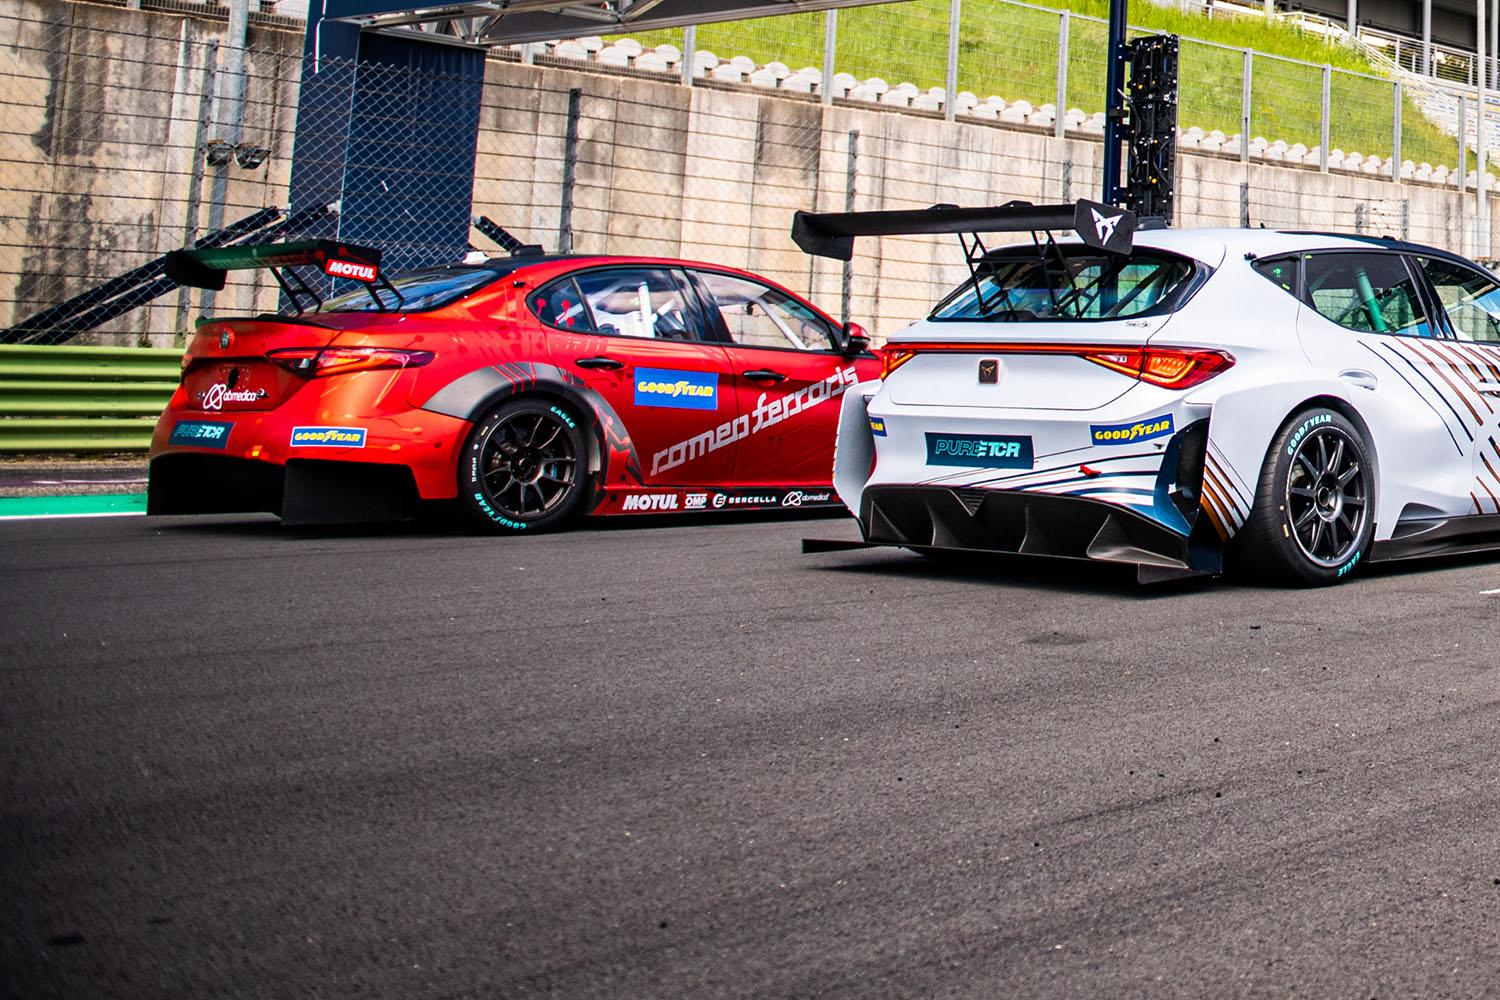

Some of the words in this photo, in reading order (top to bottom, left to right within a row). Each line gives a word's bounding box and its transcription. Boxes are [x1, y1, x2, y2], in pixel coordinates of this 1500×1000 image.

[329, 261, 374, 279] MOTUL
[637, 380, 714, 398] GOODYEAR
[550, 406, 576, 429] EAGLE
[650, 414, 749, 477] romeo
[752, 366, 859, 434] ferraris
[294, 431, 361, 443] GOODYEAR
[1094, 420, 1170, 440] GOODYEAR
[1287, 414, 1332, 456] GOODYEAR
[622, 494, 678, 510] MOTUL
[684, 495, 707, 508] OMP
[728, 495, 777, 504] BERCELLA
[1338, 550, 1360, 577] EAGLE
